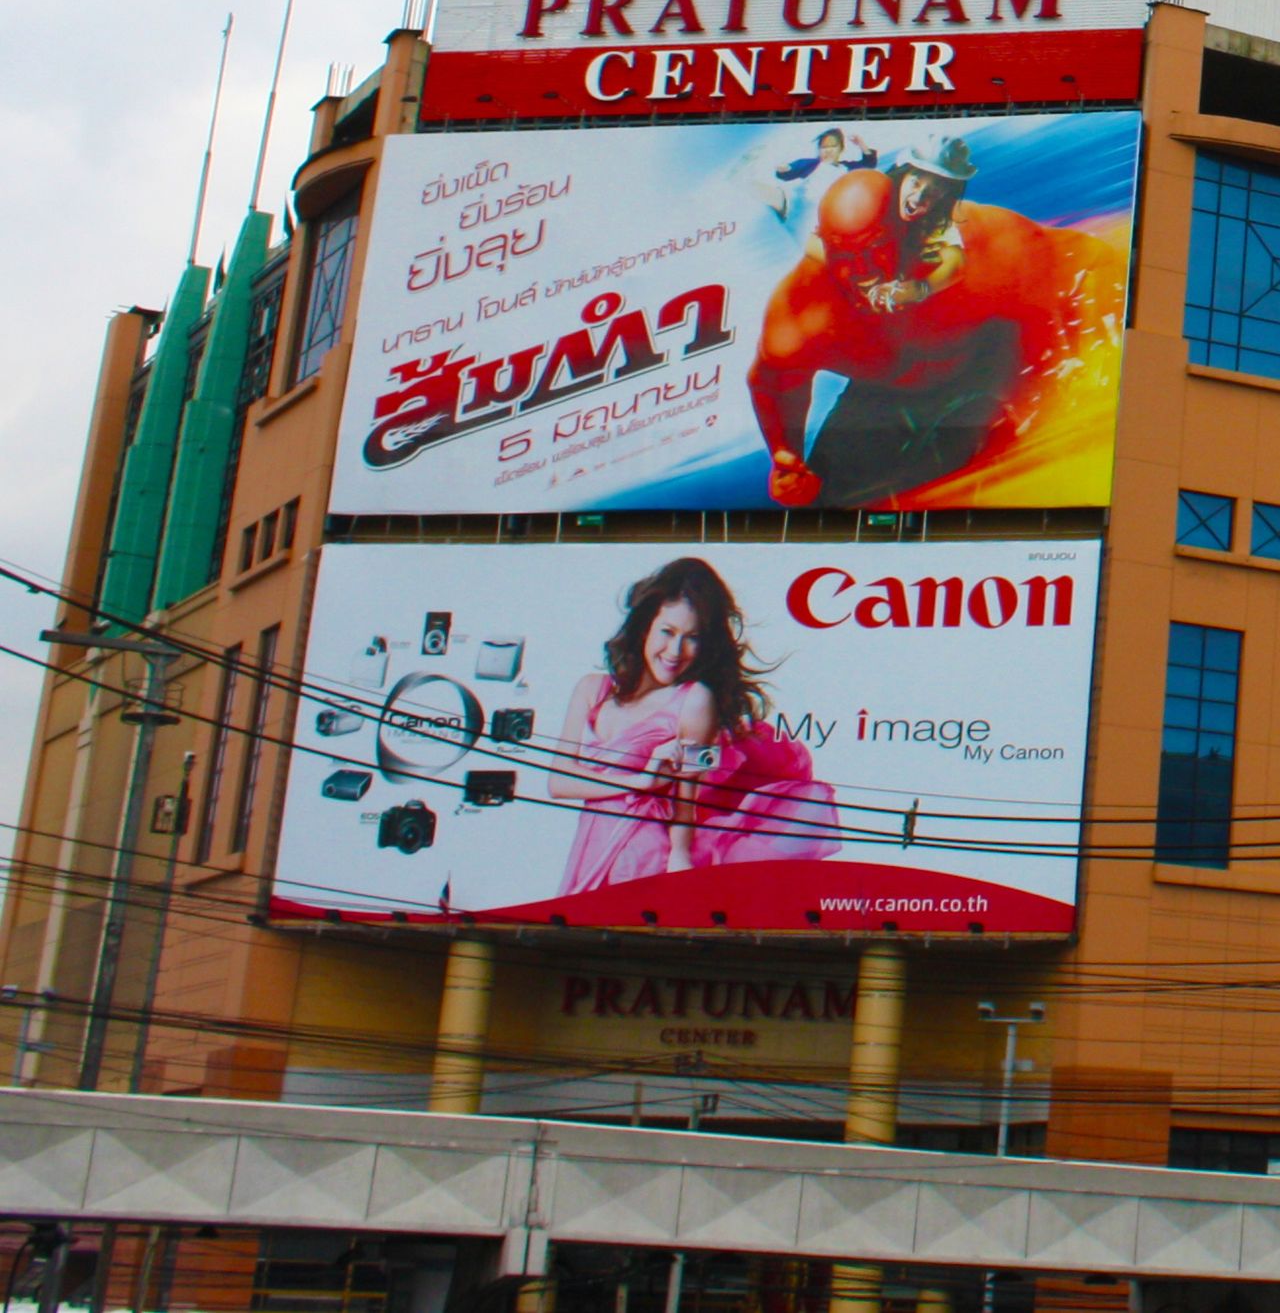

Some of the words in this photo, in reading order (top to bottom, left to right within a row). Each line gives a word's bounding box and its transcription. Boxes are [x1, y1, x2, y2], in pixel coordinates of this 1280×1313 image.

[584, 41, 956, 102] CENTER
[421, 160, 511, 206] ยิ่งเผ็ด
[459, 175, 571, 230] ยิ่งร้อน
[406, 219, 547, 293] ยิ่งลุย
[497, 429, 533, 463] 5
[552, 365, 722, 444] มิถุนายน
[786, 567, 1074, 629] Canon
[774, 713, 837, 747] My
[856, 708, 991, 749] image
[963, 745, 994, 764] My
[999, 744, 1064, 760] Canon
[820, 895, 988, 913] www.canon.co.th
[559, 976, 860, 1019] PRATUNAM
[660, 1028, 756, 1047] CENTER
